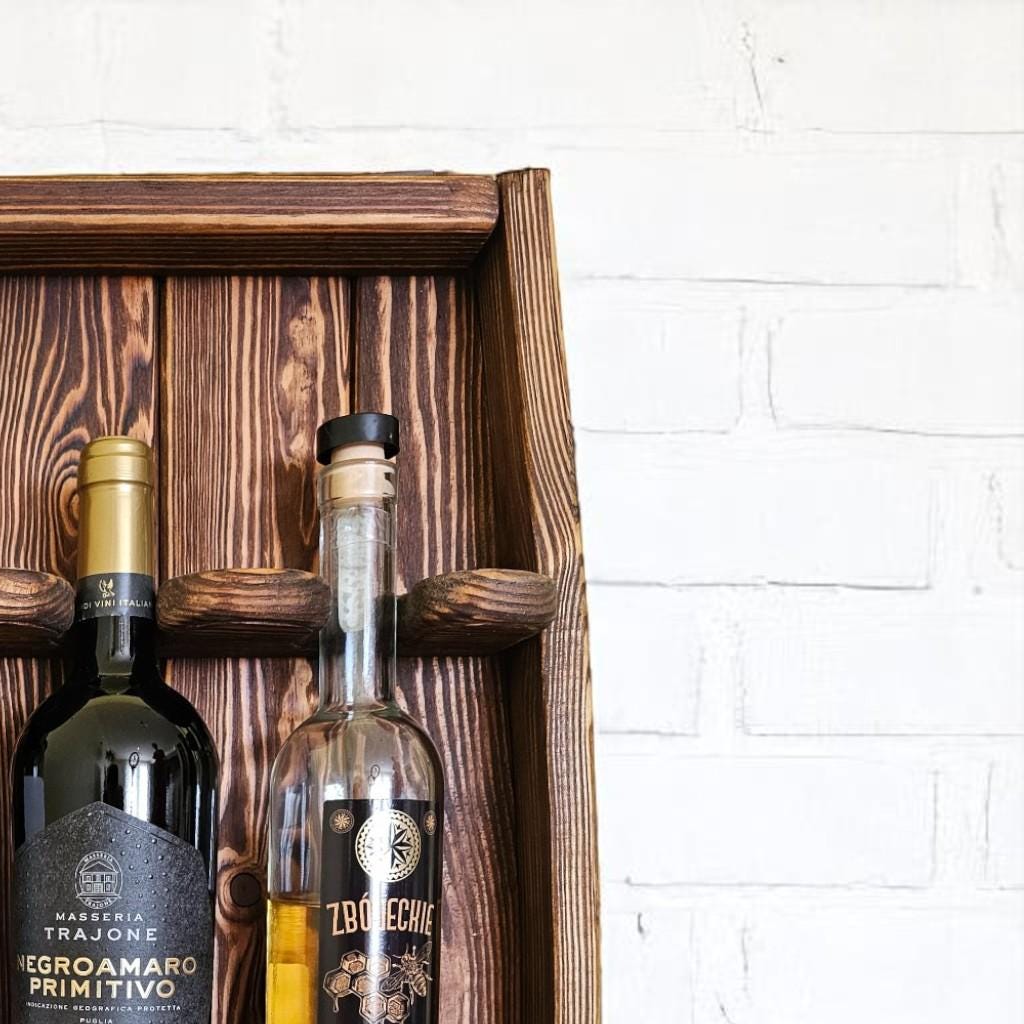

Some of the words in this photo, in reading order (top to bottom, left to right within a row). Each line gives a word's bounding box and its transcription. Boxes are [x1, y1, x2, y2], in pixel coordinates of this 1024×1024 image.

[94, 599, 115, 608] VINI
[56, 912, 144, 922] MASSERIA
[43, 927, 158, 941] TRAJONE
[17, 953, 197, 977] NEGROAMARO
[29, 977, 176, 999] PRIMITIVO
[26, 1001, 69, 1011] INDICAZIONE
[73, 1004, 133, 1012] GEOGRAFICA
[137, 1004, 181, 1012] PROTETTA
[79, 1017, 114, 1024] PUGLIA
